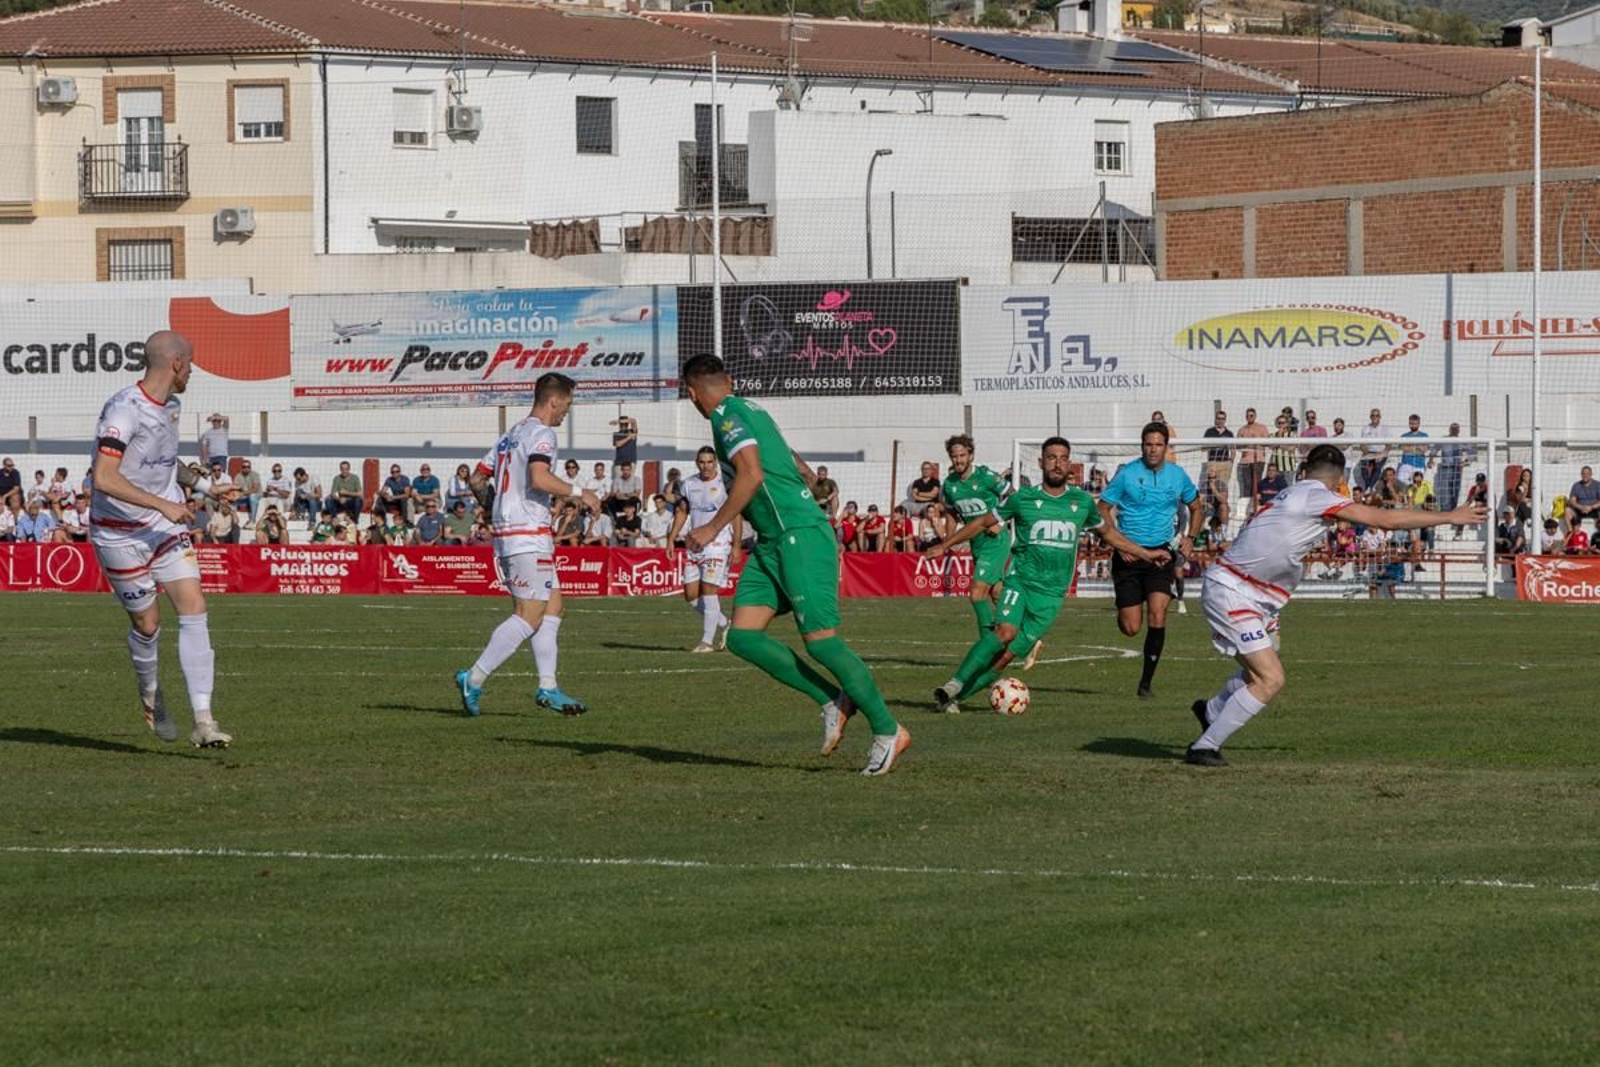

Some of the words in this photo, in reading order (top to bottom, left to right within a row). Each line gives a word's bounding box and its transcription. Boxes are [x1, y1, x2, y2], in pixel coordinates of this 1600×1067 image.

[476, 298, 513, 312] volar
[795, 312, 835, 323] EVENTOS
[812, 321, 853, 329] MARTOS
[1188, 325, 1393, 350] INAMARSA
[3, 333, 148, 374] cardos
[875, 375, 943, 388] 645310153
[973, 375, 1065, 391] TERMOPLASTICOS
[270, 563, 349, 576] MARKOS
[123, 589, 146, 600] GLS
[1241, 630, 1265, 642] GLS
